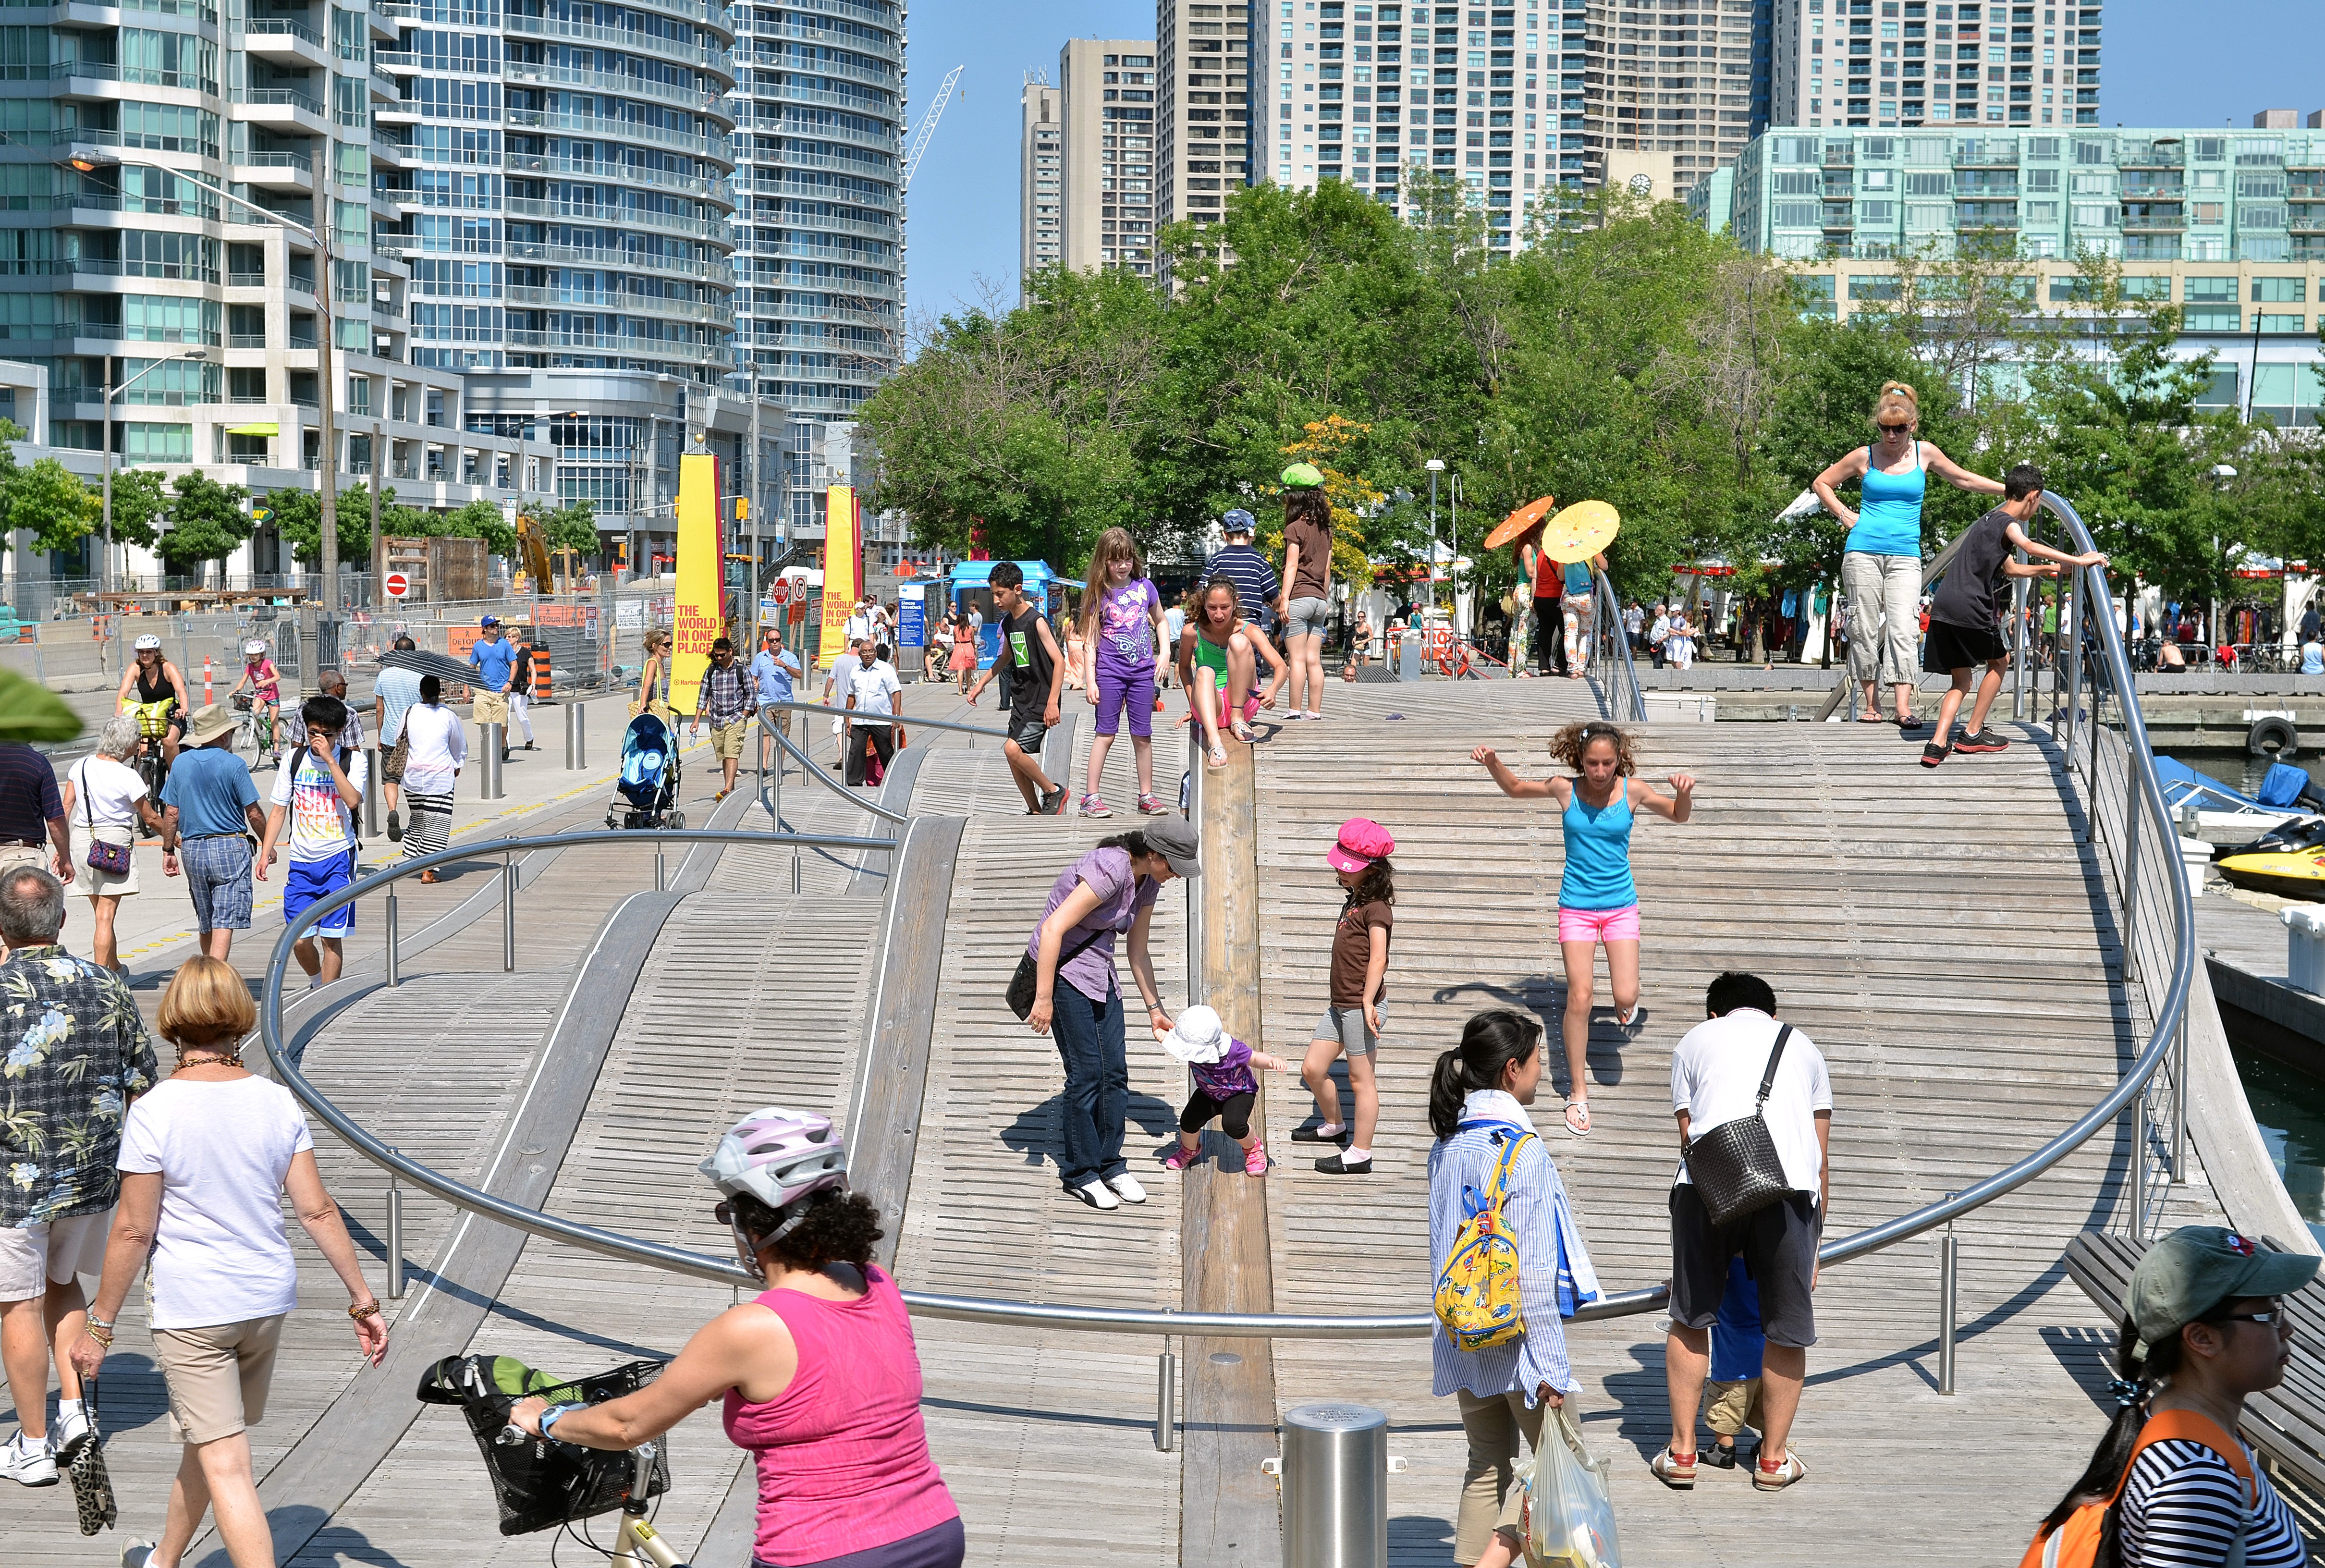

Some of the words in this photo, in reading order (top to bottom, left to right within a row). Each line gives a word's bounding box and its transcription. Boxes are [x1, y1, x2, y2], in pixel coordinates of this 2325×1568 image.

[775, 586, 788, 596] STOP
[678, 605, 699, 616] THE
[678, 618, 717, 629] WORLD
[678, 630, 688, 641] IN
[692, 630, 713, 641] ONE
[1010, 632, 1025, 642] PUMA
[677, 642, 712, 654] PLACE
